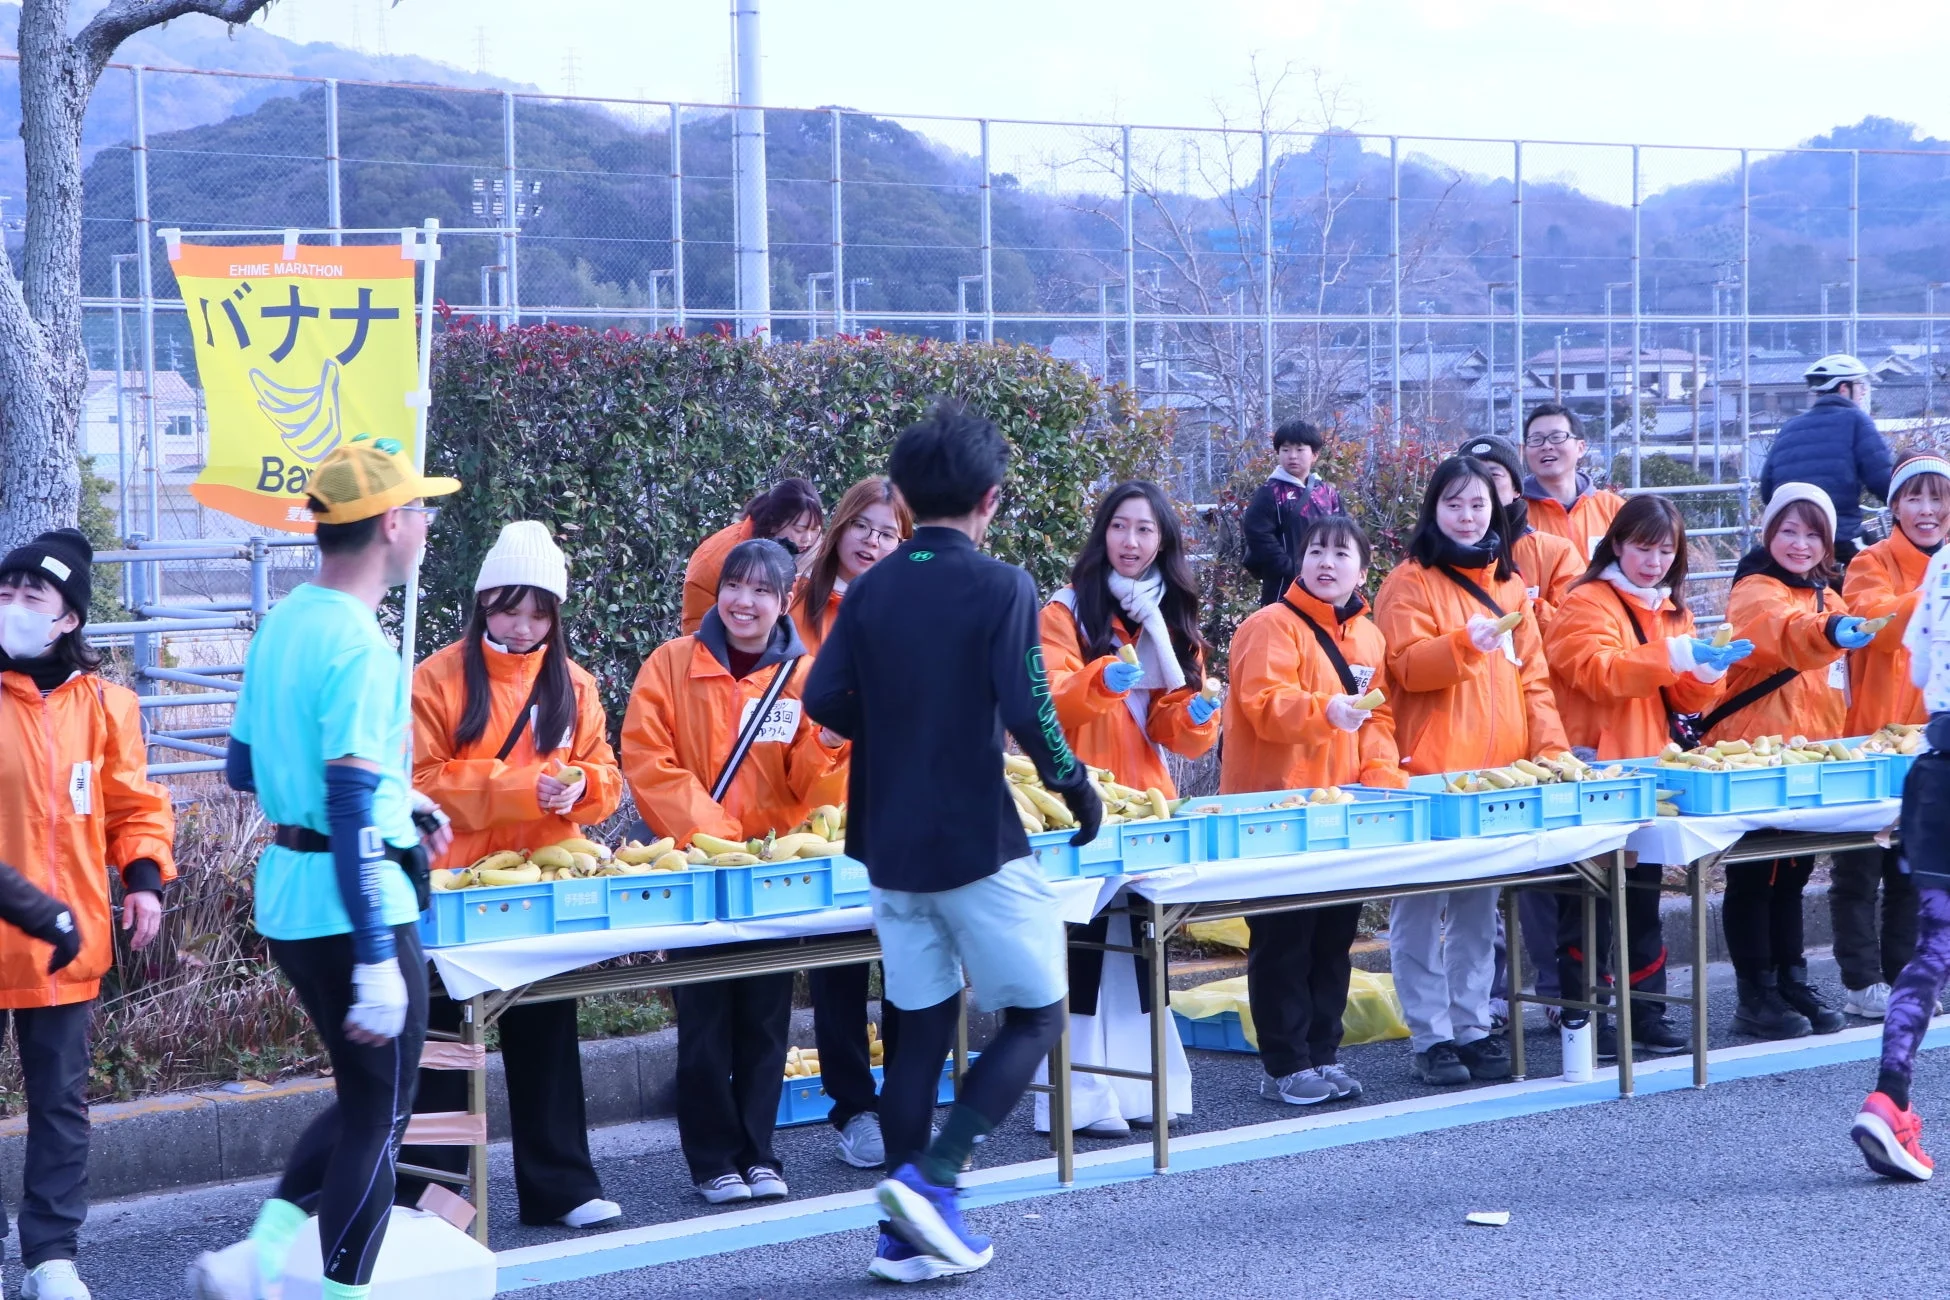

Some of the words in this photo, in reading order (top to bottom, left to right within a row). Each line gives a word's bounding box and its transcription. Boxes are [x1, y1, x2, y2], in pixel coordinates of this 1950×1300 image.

[229, 264, 270, 276] EHIME
[274, 262, 342, 277] MARATHON
[199, 281, 399, 366] バナナ
[256, 456, 313, 494] Ba
